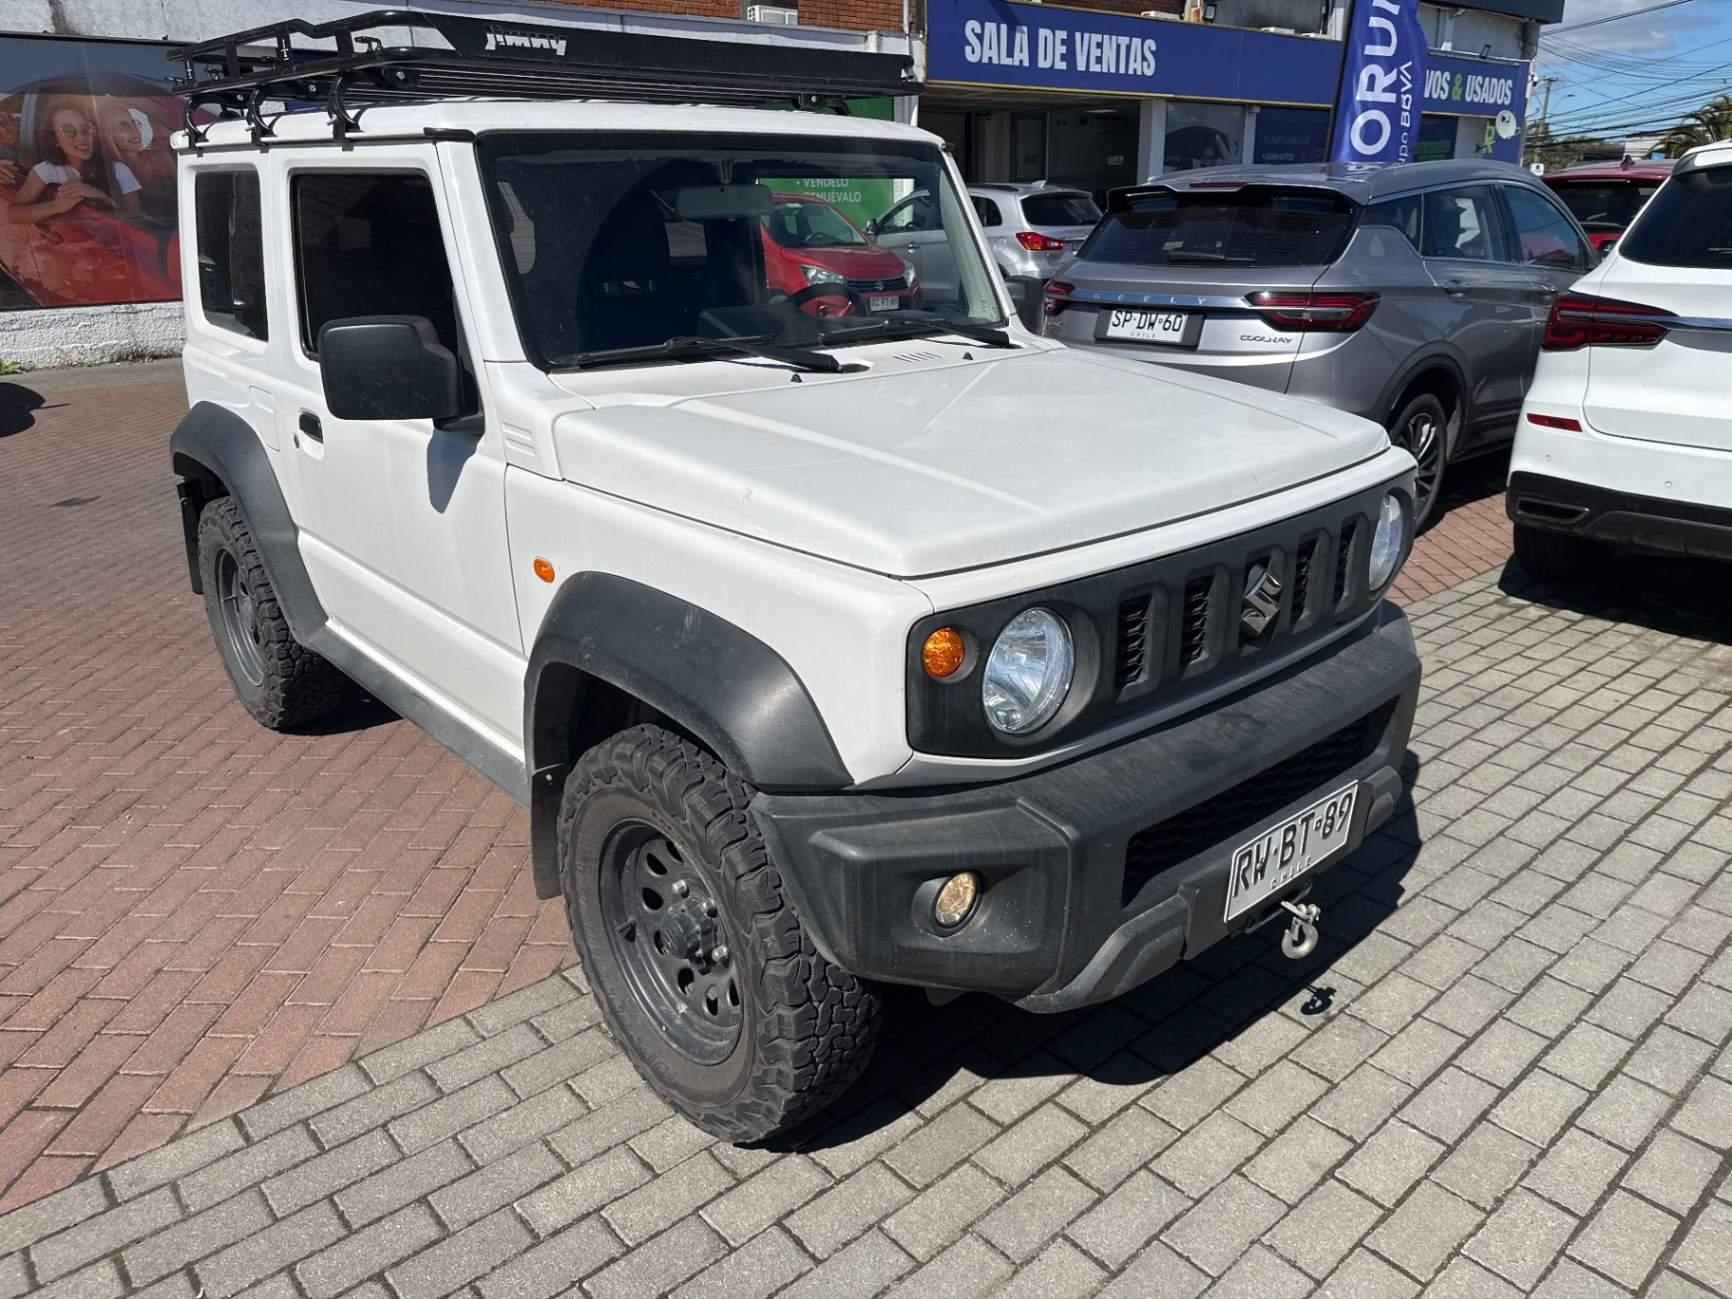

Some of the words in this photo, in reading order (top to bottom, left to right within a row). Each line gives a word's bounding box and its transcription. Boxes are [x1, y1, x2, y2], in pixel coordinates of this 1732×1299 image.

[964, 19, 1030, 67] SALA
[1037, 27, 1068, 70] DE
[1074, 31, 1157, 77] VENTAS
[1452, 73, 1463, 101] &
[1465, 75, 1513, 105] USADOS
